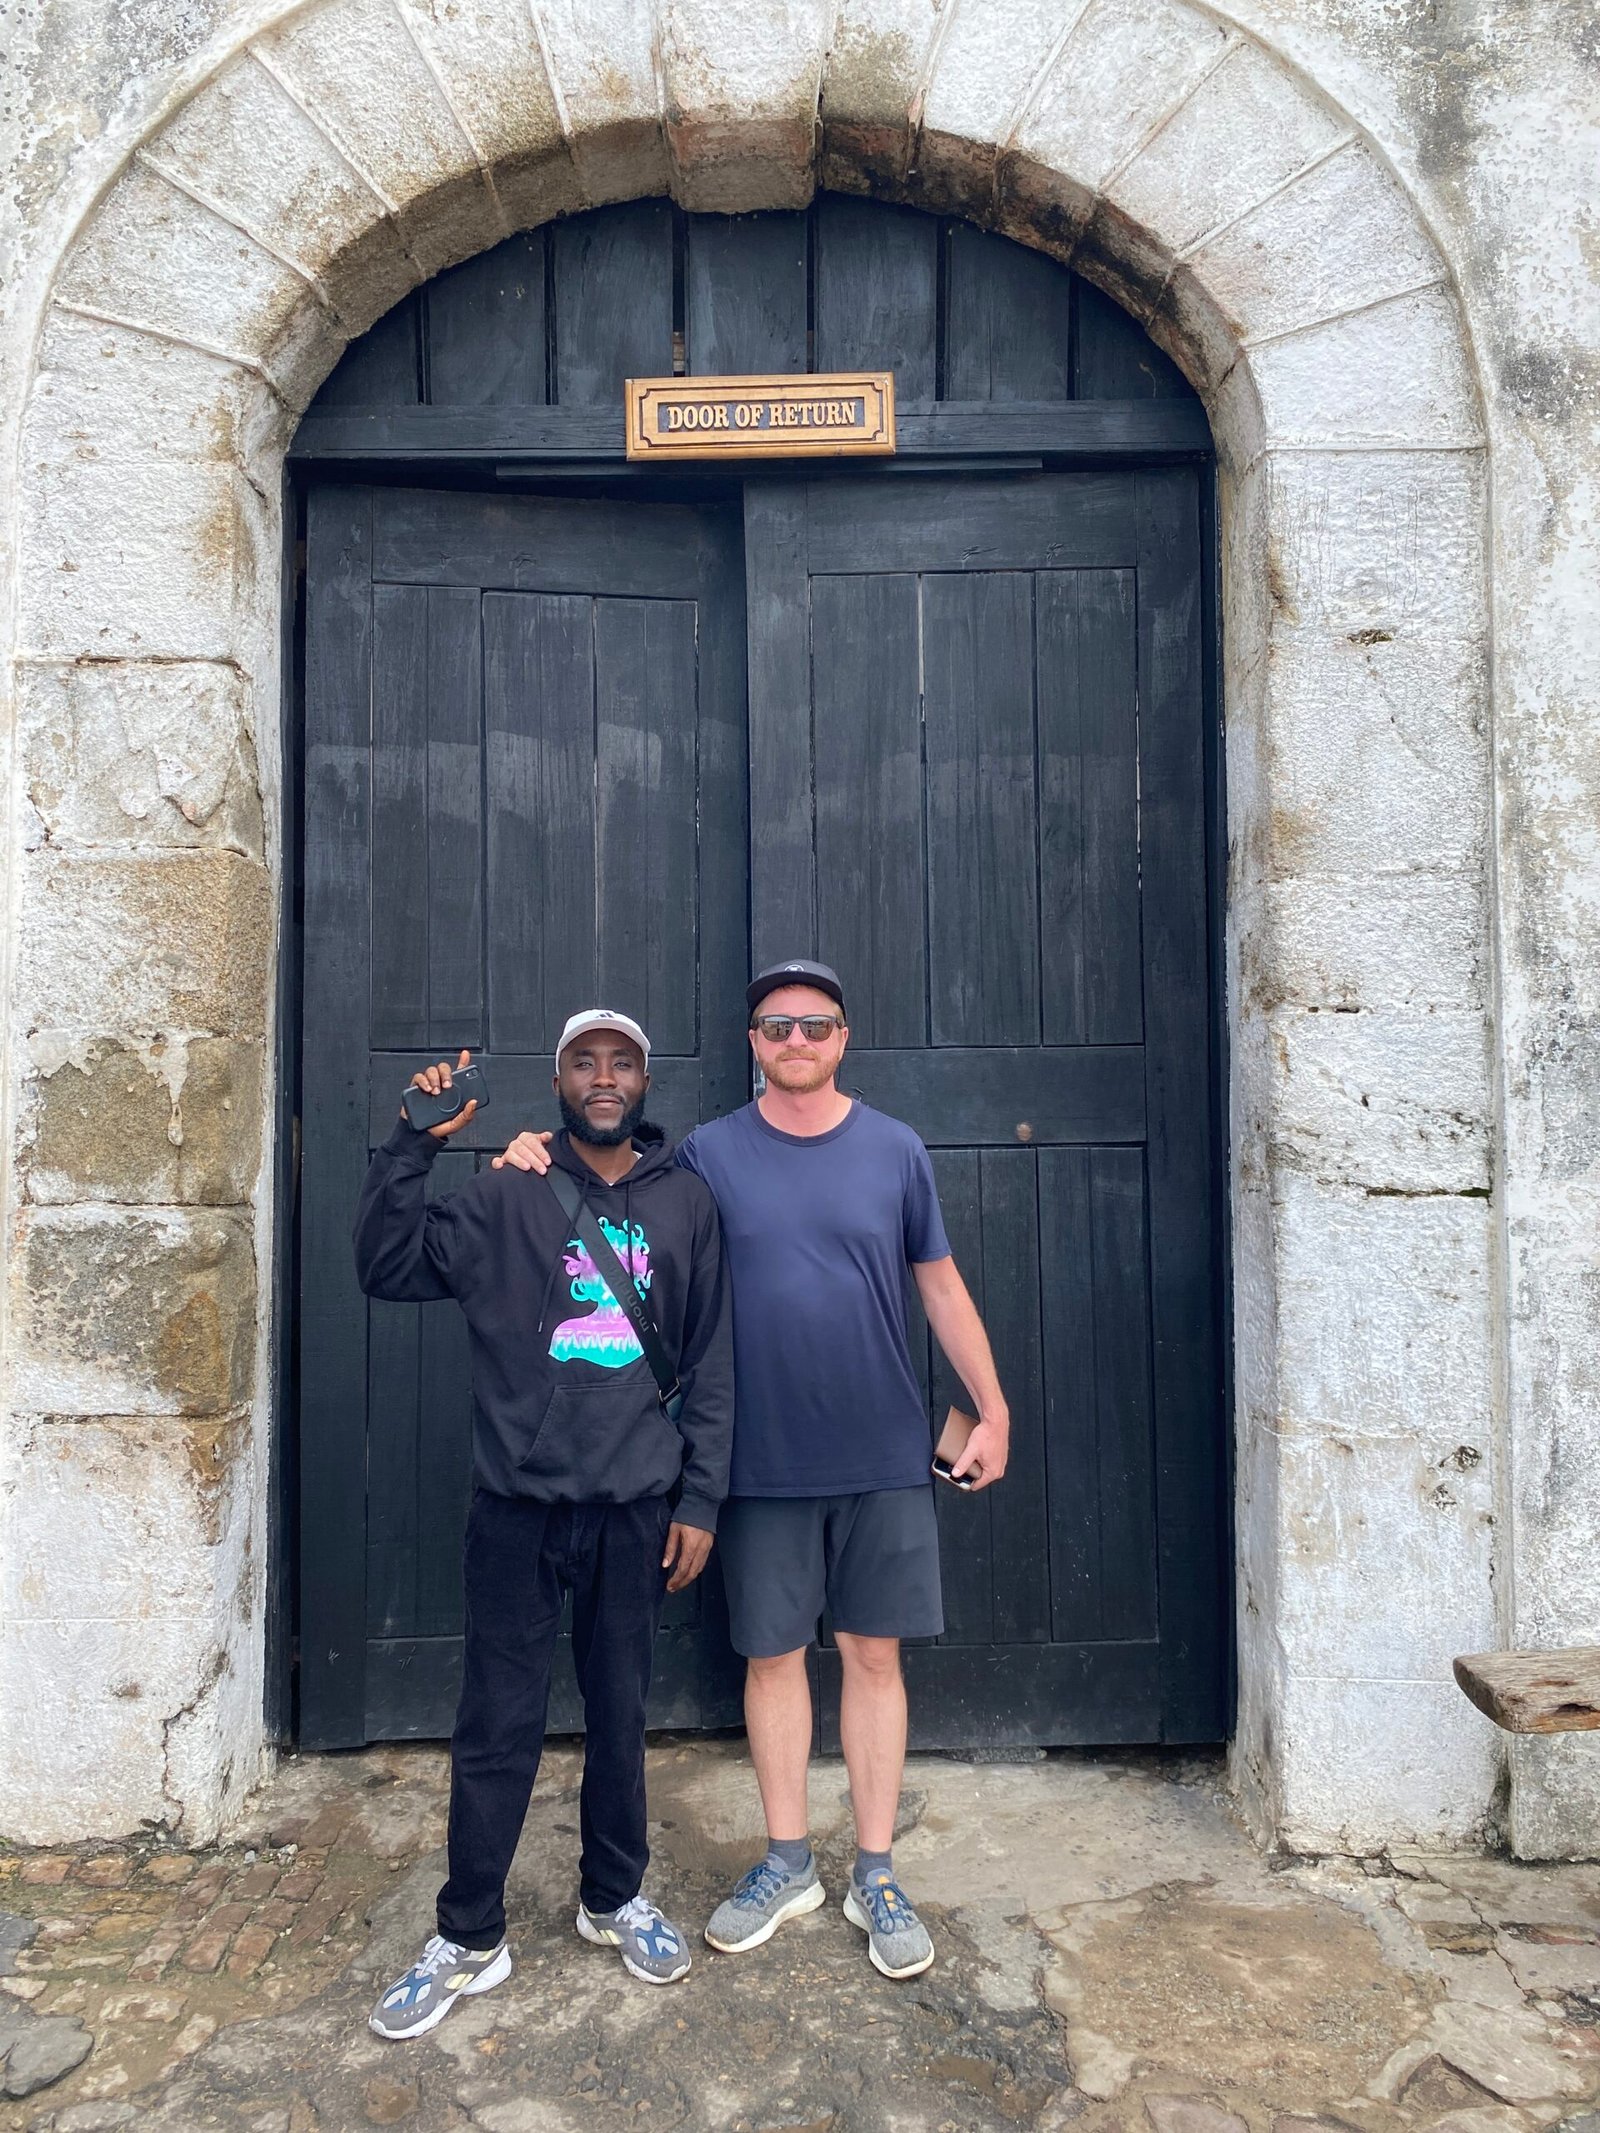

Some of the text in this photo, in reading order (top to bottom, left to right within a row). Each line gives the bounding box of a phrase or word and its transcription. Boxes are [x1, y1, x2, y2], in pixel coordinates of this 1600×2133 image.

[667, 401, 856, 430] DOOR OF RETURN
